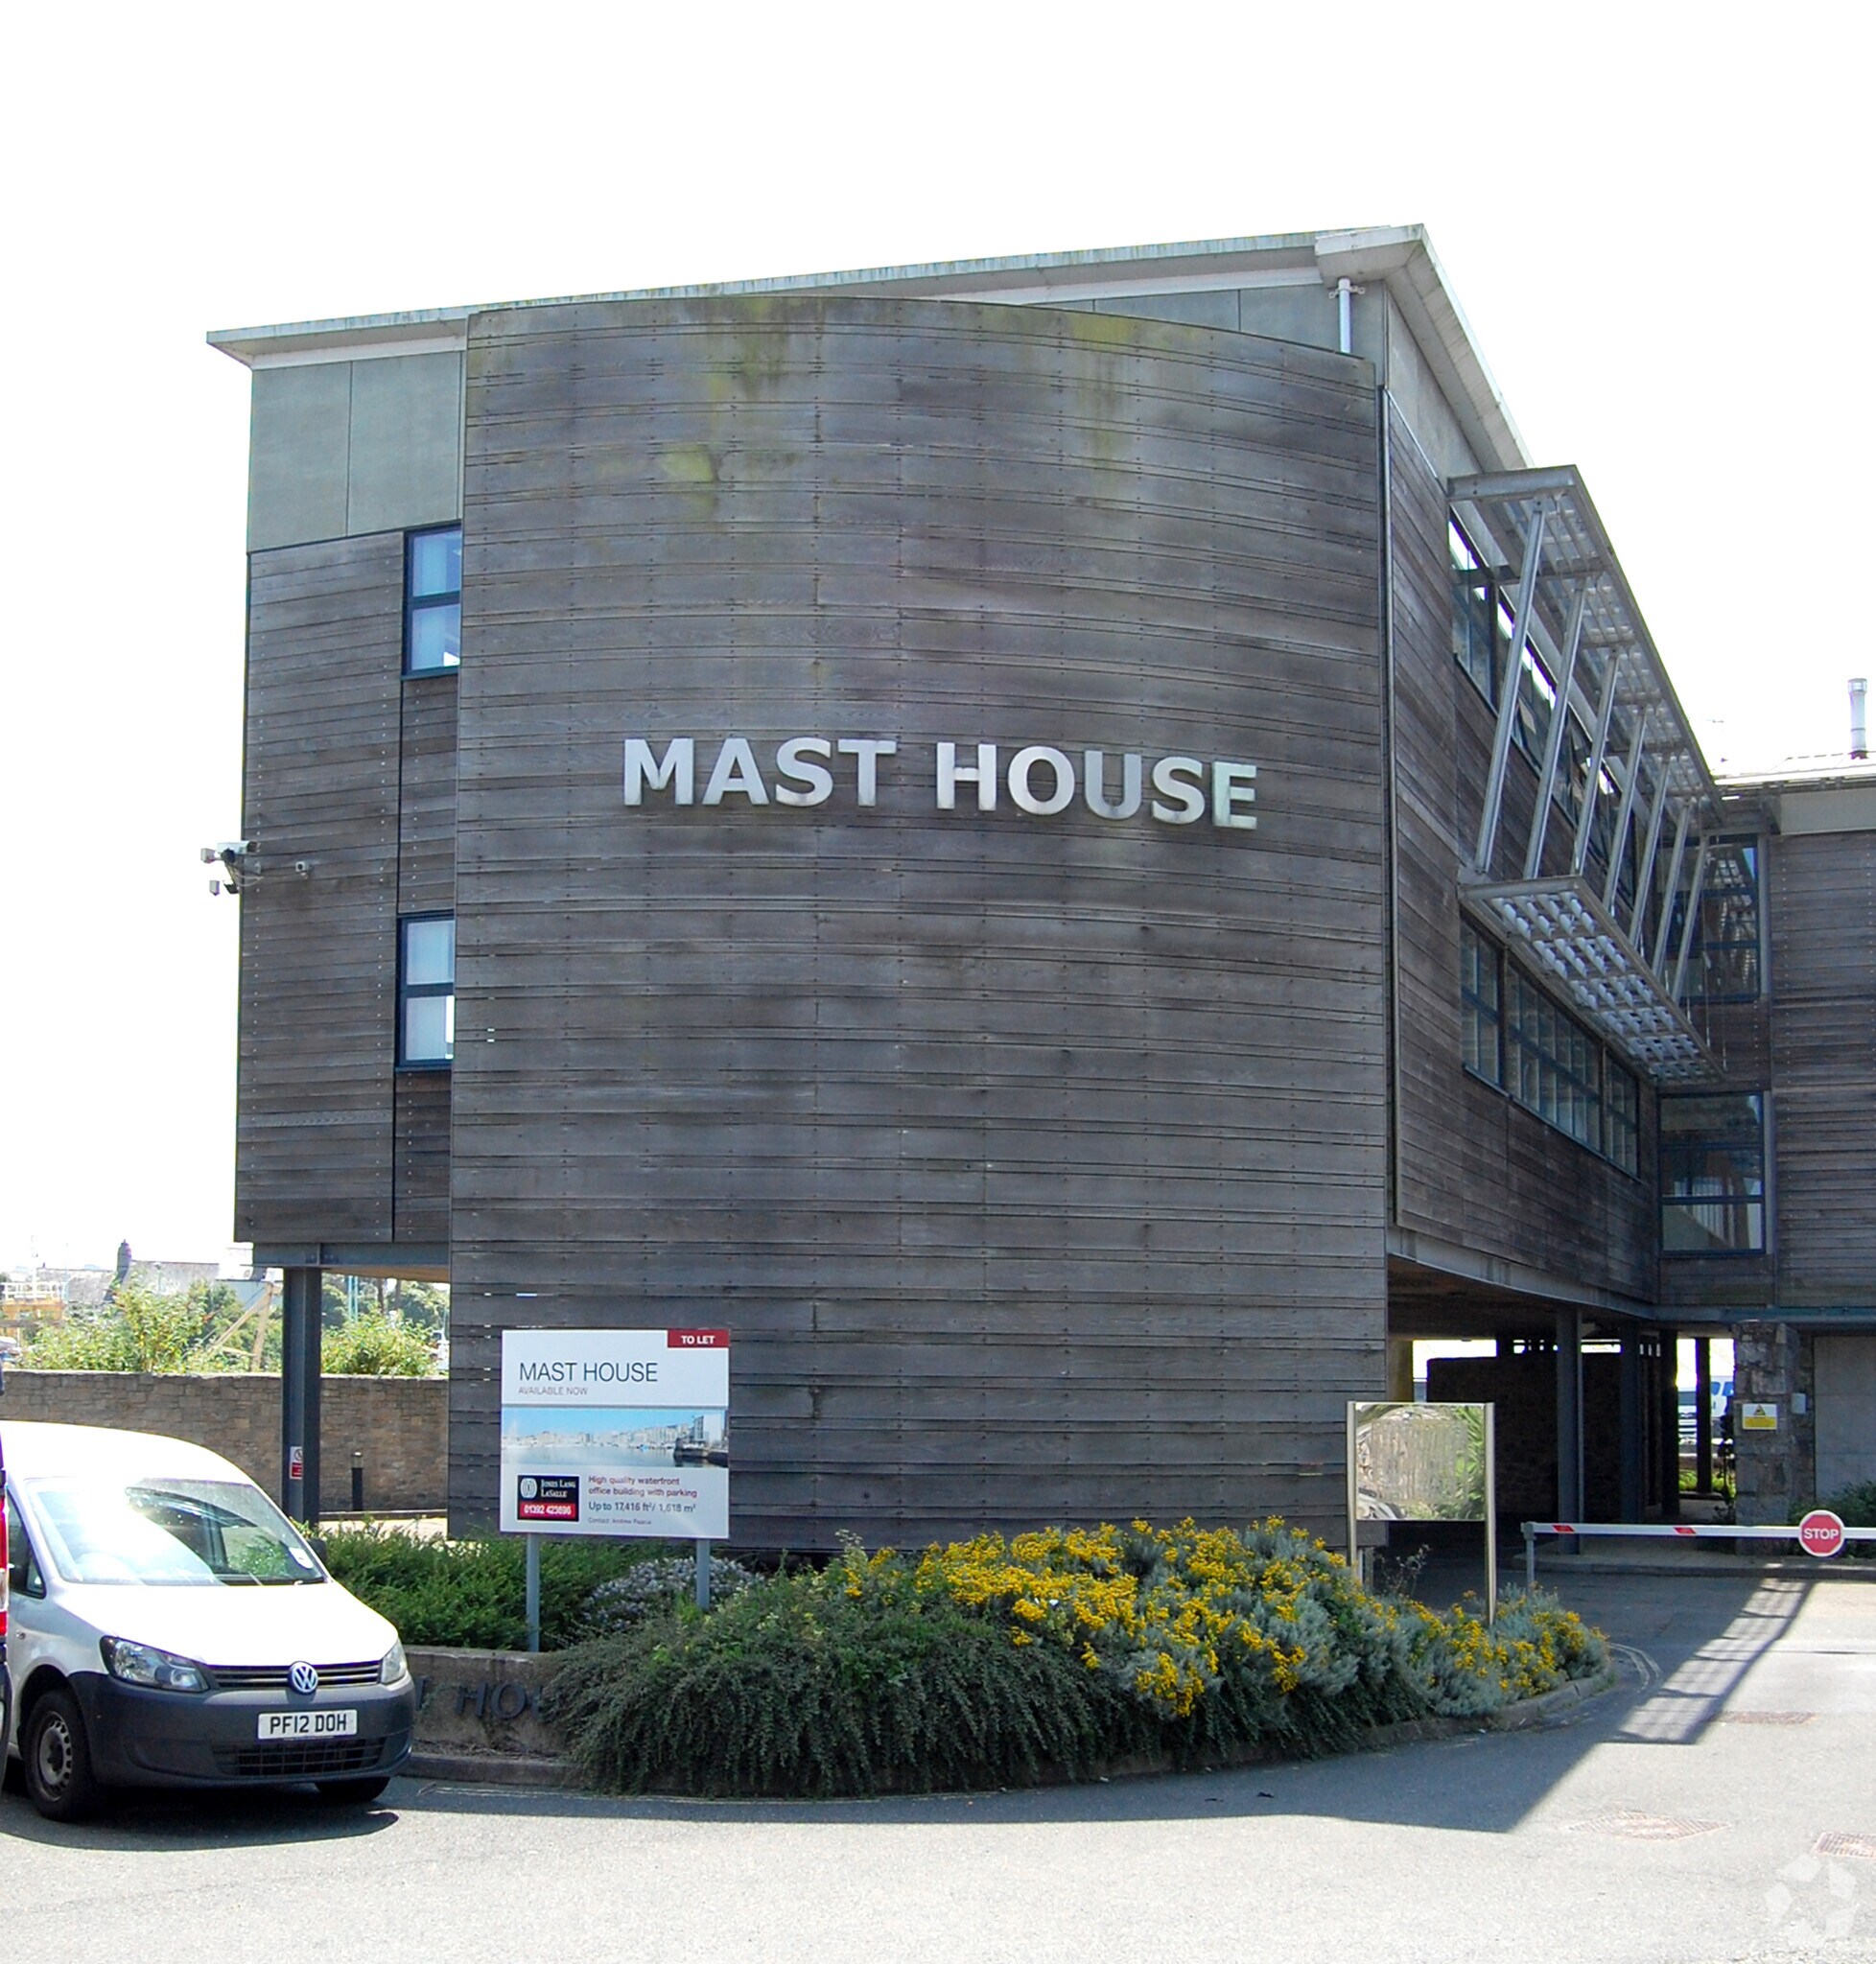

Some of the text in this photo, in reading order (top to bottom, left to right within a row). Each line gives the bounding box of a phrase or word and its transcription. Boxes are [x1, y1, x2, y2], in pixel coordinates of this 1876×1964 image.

[623, 737, 1258, 830] MAST HOUSE
[681, 1335, 715, 1344] TO LET
[519, 1362, 659, 1382] MAST HOUSE
[518, 1387, 589, 1396] AVAILABLE NOW
[588, 1476, 680, 1485] High quality waterfront
[588, 1486, 611, 1495] office
[613, 1487, 645, 1497] building
[667, 1488, 698, 1498] parking
[588, 1501, 601, 1512] Up
[602, 1502, 613, 1510] to
[1803, 1528, 1840, 1540] STOP
[270, 1713, 347, 1735] PF12 DOH
